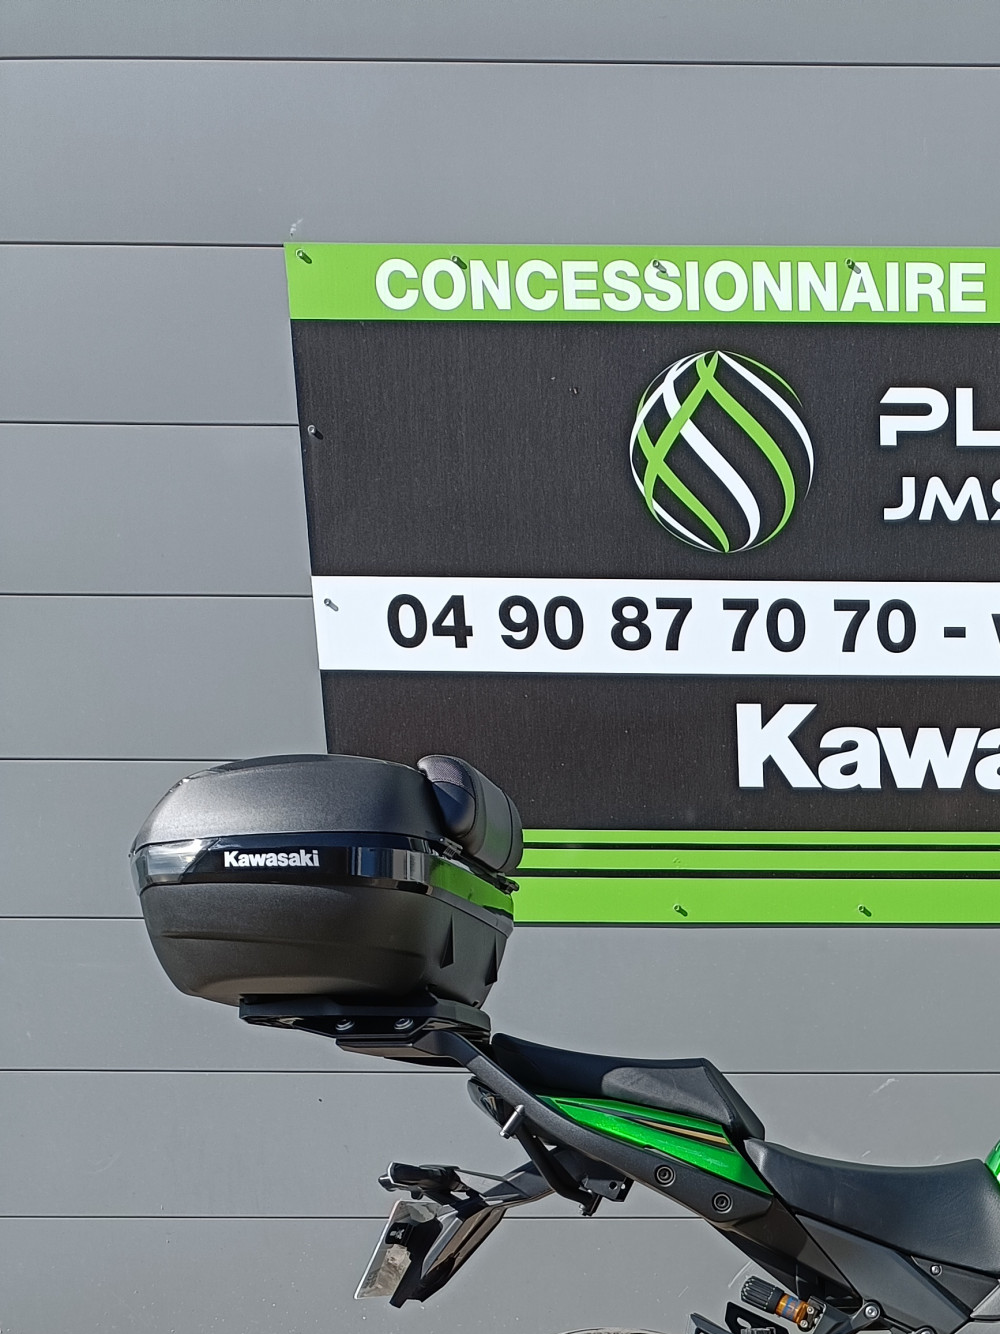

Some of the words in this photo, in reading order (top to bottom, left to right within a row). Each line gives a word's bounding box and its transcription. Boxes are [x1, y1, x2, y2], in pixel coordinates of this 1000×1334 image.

[375, 258, 986, 313] CONCESSIONNAIRE
[388, 594, 473, 648] 04
[499, 596, 583, 650] 90
[611, 597, 692, 650] 87
[723, 599, 805, 652] 70
[834, 600, 916, 653] 70
[223, 849, 320, 868] Kawasaki
